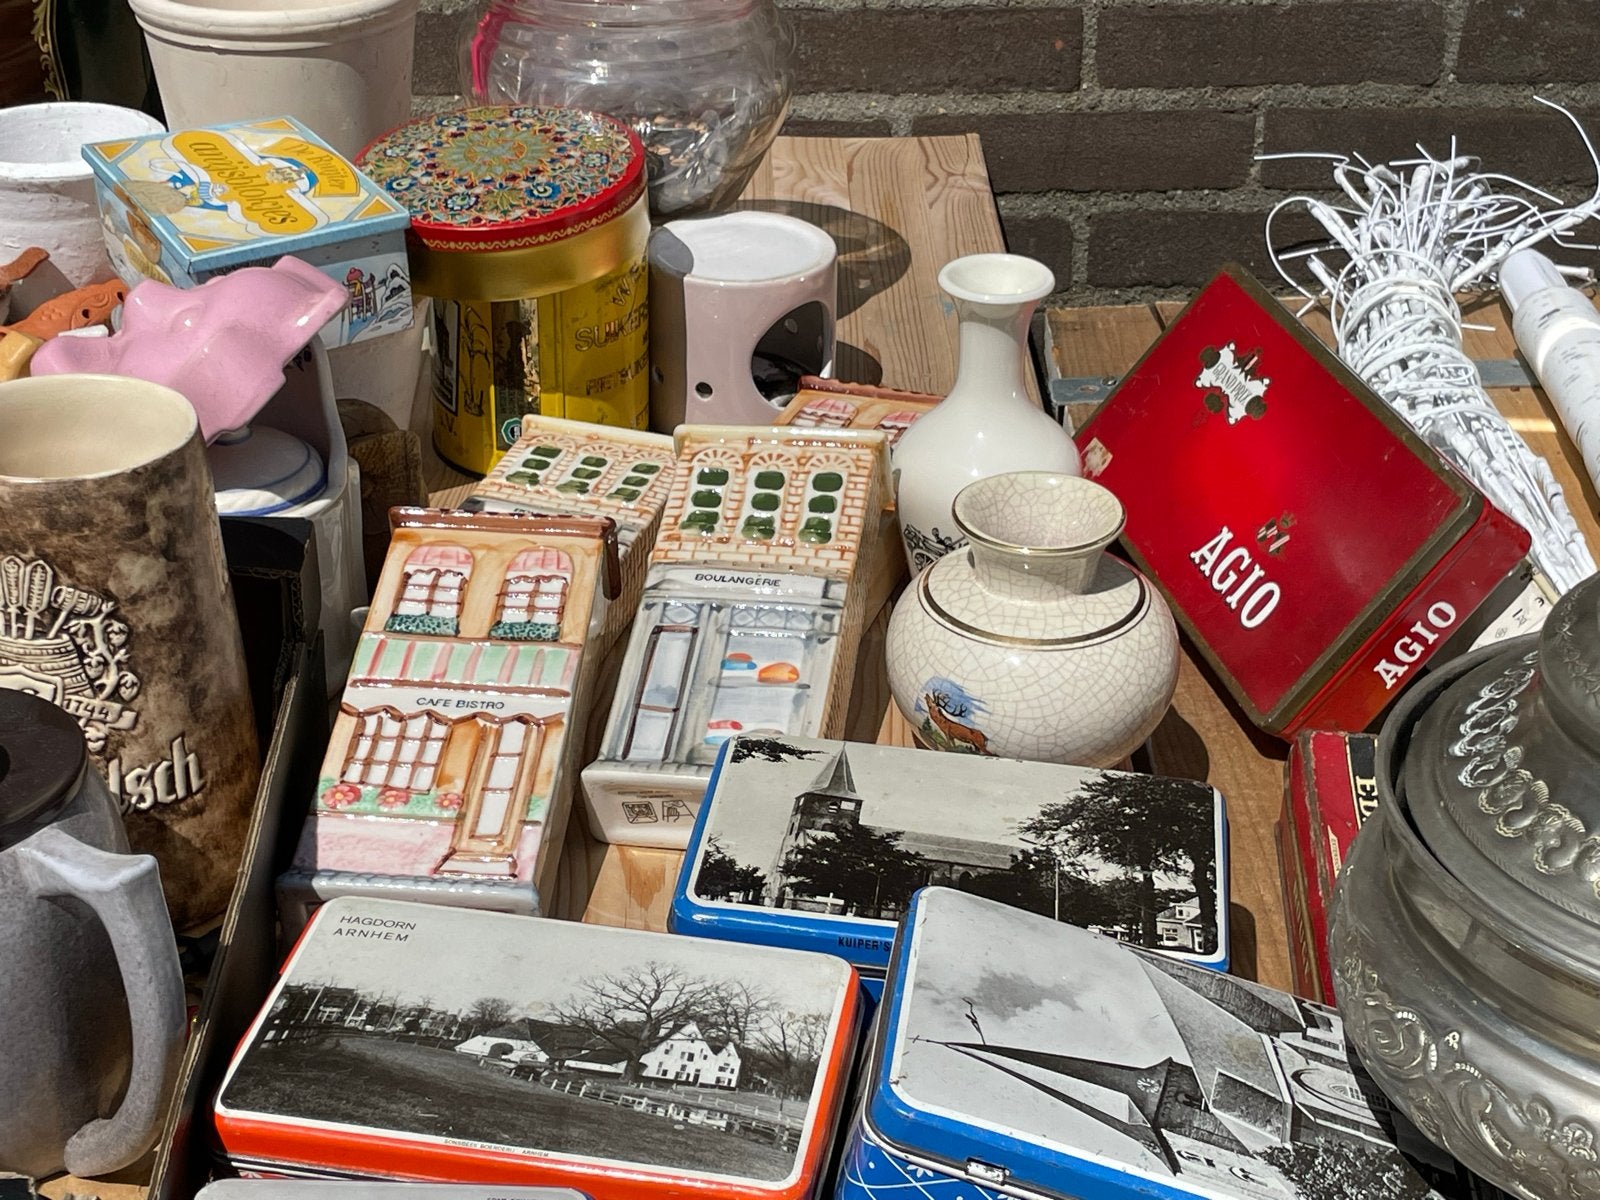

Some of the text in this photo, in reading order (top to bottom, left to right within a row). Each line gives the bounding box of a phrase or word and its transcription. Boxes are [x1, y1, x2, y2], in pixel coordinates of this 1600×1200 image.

[188, 141, 298, 226] anijsblokjes
[1211, 361, 1254, 406] GRAND PRIX
[1189, 525, 1281, 629] AGIO
[1373, 601, 1457, 690] AGIO
[64, 698, 110, 720] 1744
[416, 697, 505, 710] CAFE BISTRO
[107, 731, 206, 813] lsch
[332, 927, 409, 942] ARNHEM
[339, 915, 417, 931] HAGDORN
[837, 936, 891, 953] KUIPER'S
